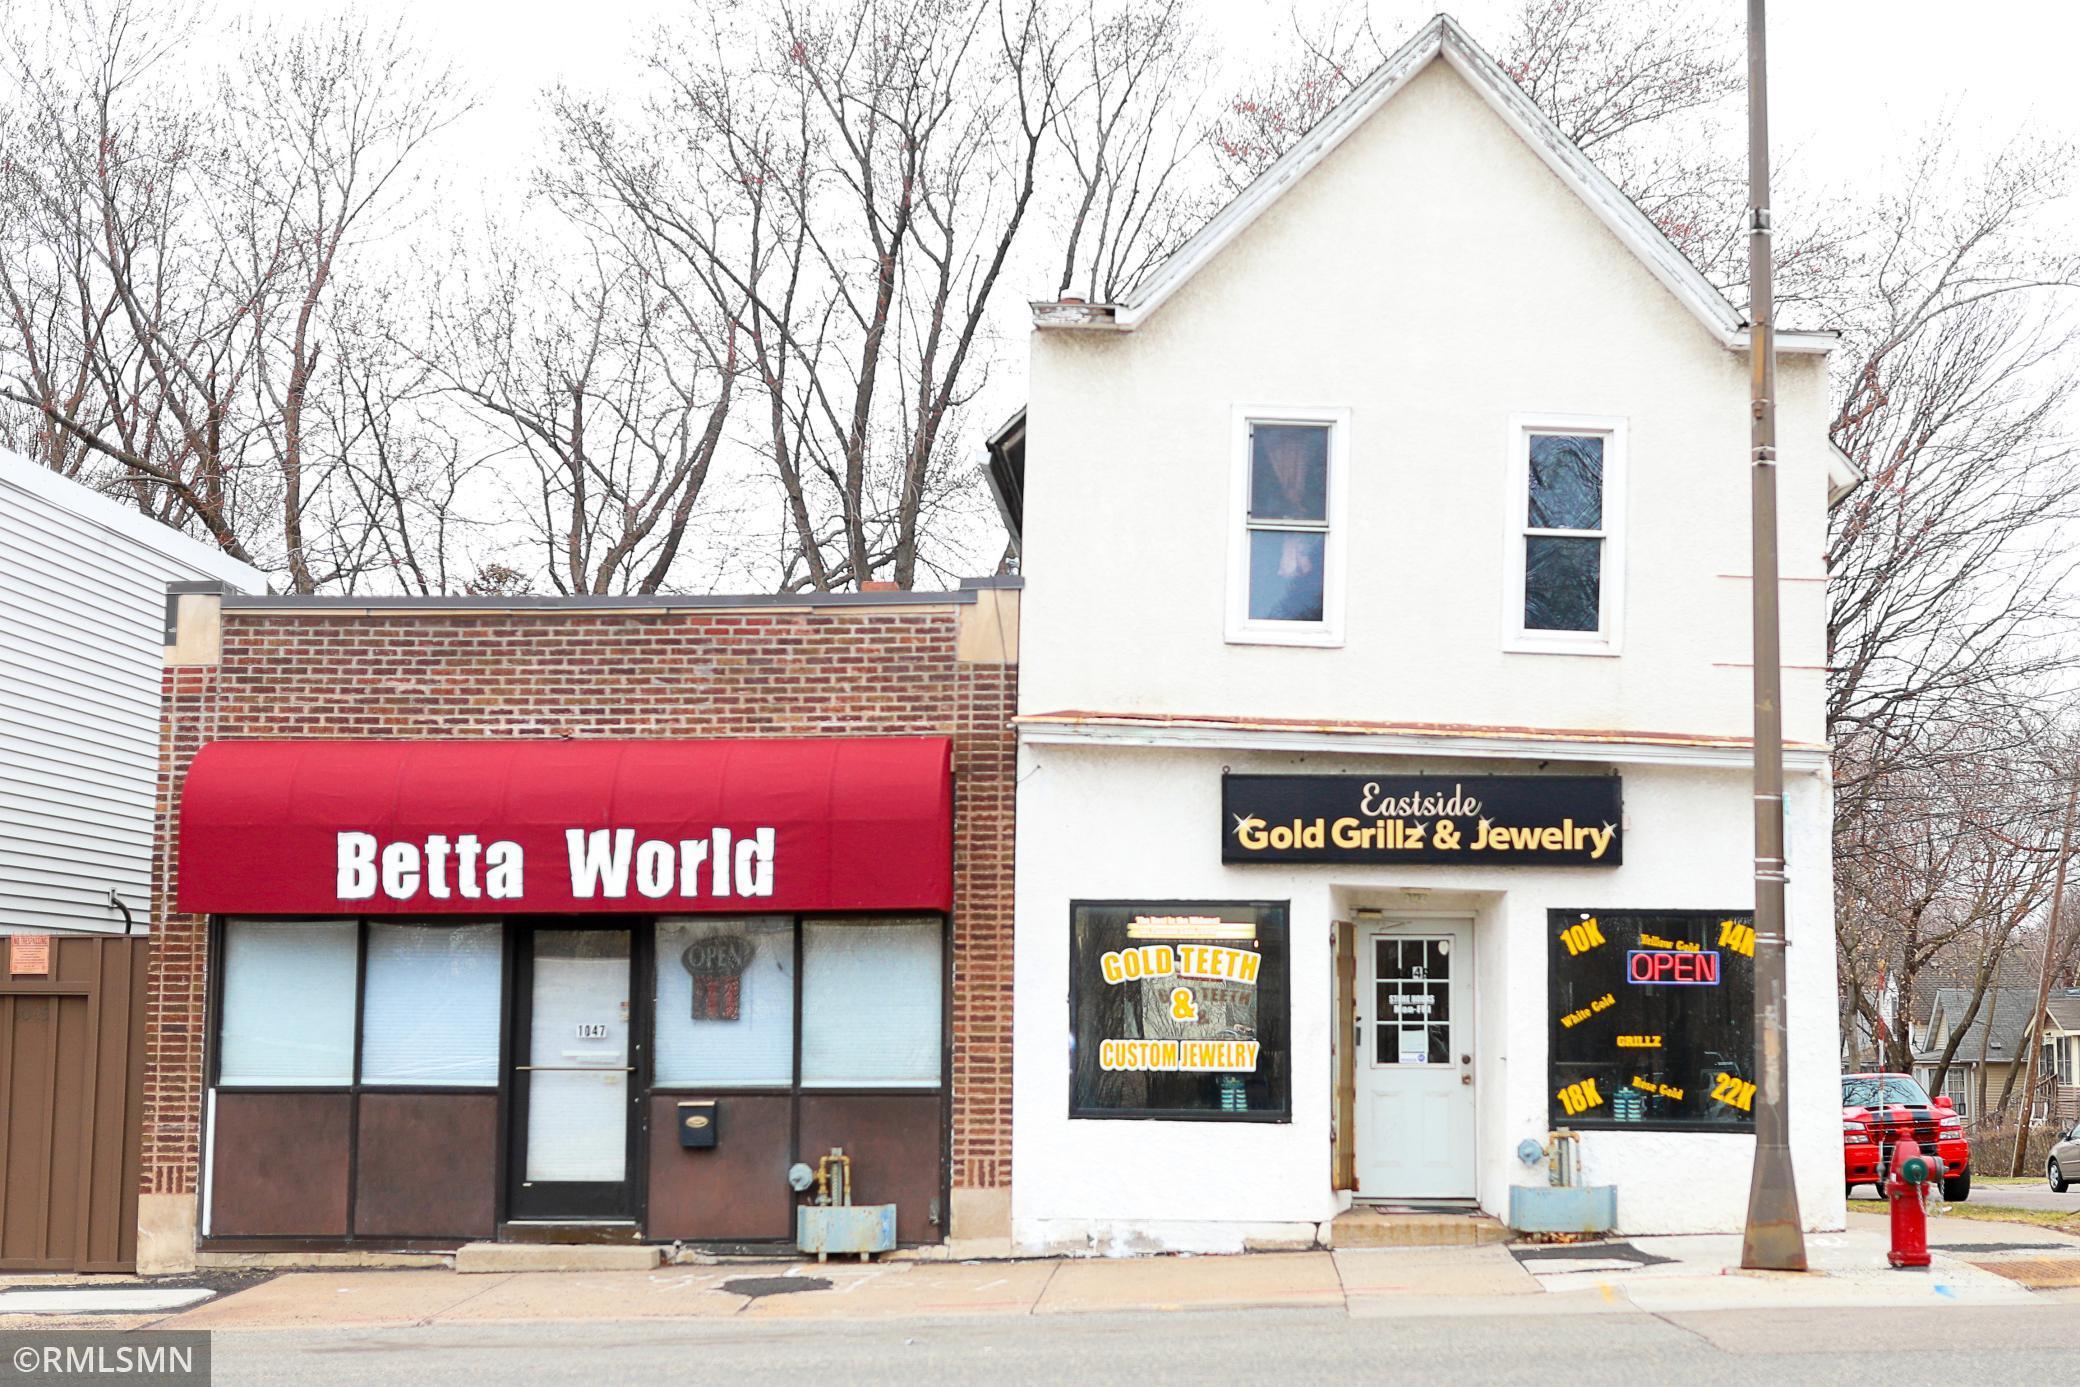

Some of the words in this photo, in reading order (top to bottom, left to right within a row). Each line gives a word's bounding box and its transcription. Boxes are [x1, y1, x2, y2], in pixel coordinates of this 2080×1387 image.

[1360, 782, 1482, 817] Eastside
[1236, 818, 1324, 850] Gold
[1331, 817, 1426, 850] Grillz
[1432, 820, 1461, 850] &
[1470, 817, 1613, 859] Jewelry
[336, 831, 524, 899] Betta
[565, 827, 776, 898] World
[1560, 917, 1606, 956] 10K
[689, 944, 743, 969] OPEN
[1102, 946, 1173, 983] GOLD
[1178, 946, 1260, 983] TEETH
[1631, 953, 1716, 981] OPEN
[1172, 989, 1197, 1020] &
[1560, 1009, 1592, 1029] White
[1591, 993, 1616, 1013] Gold
[578, 1025, 606, 1037] 1047
[1616, 1035, 1662, 1048] GRILLZ
[1102, 1042, 1178, 1068] CUSTOM
[1180, 1042, 1259, 1069] JEWELRY
[1556, 1077, 1604, 1116] 18K
[1710, 1072, 1757, 1112] 22K
